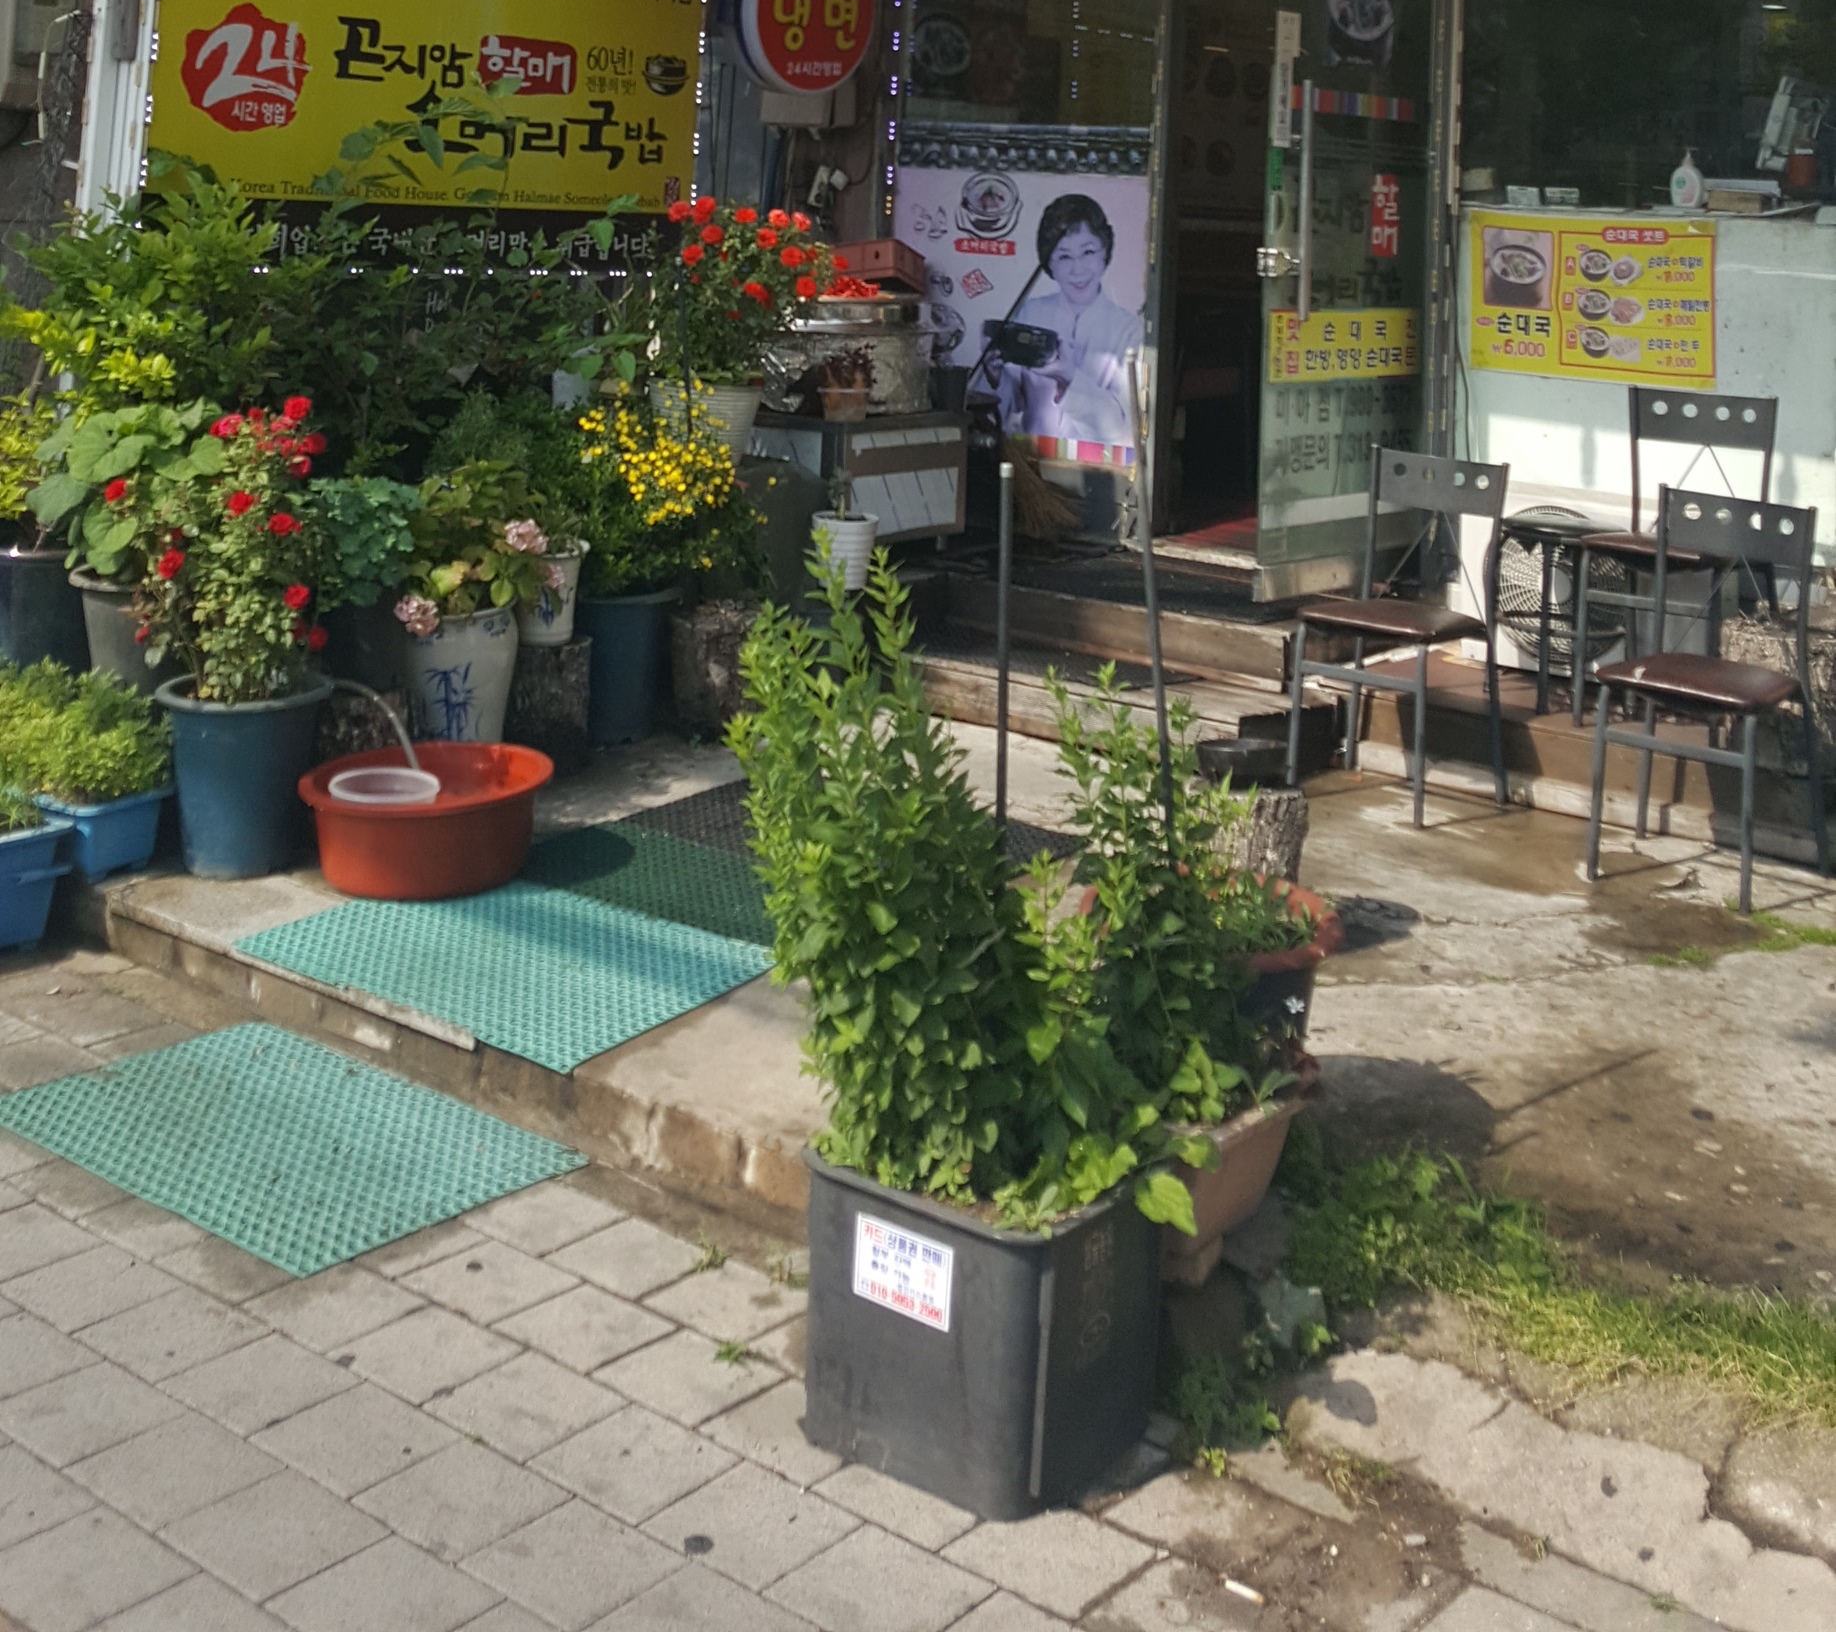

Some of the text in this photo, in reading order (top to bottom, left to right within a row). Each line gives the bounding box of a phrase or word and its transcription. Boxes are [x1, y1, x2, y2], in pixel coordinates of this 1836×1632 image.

[333, 15, 474, 89] 곤지암
[586, 46, 635, 77] 60년!
[232, 99, 287, 126] 시간 영업
[364, 185, 399, 200] Food
[513, 189, 562, 205] Halmae
[1322, 319, 1388, 343] 순대국
[1497, 312, 1551, 338] 순대국
